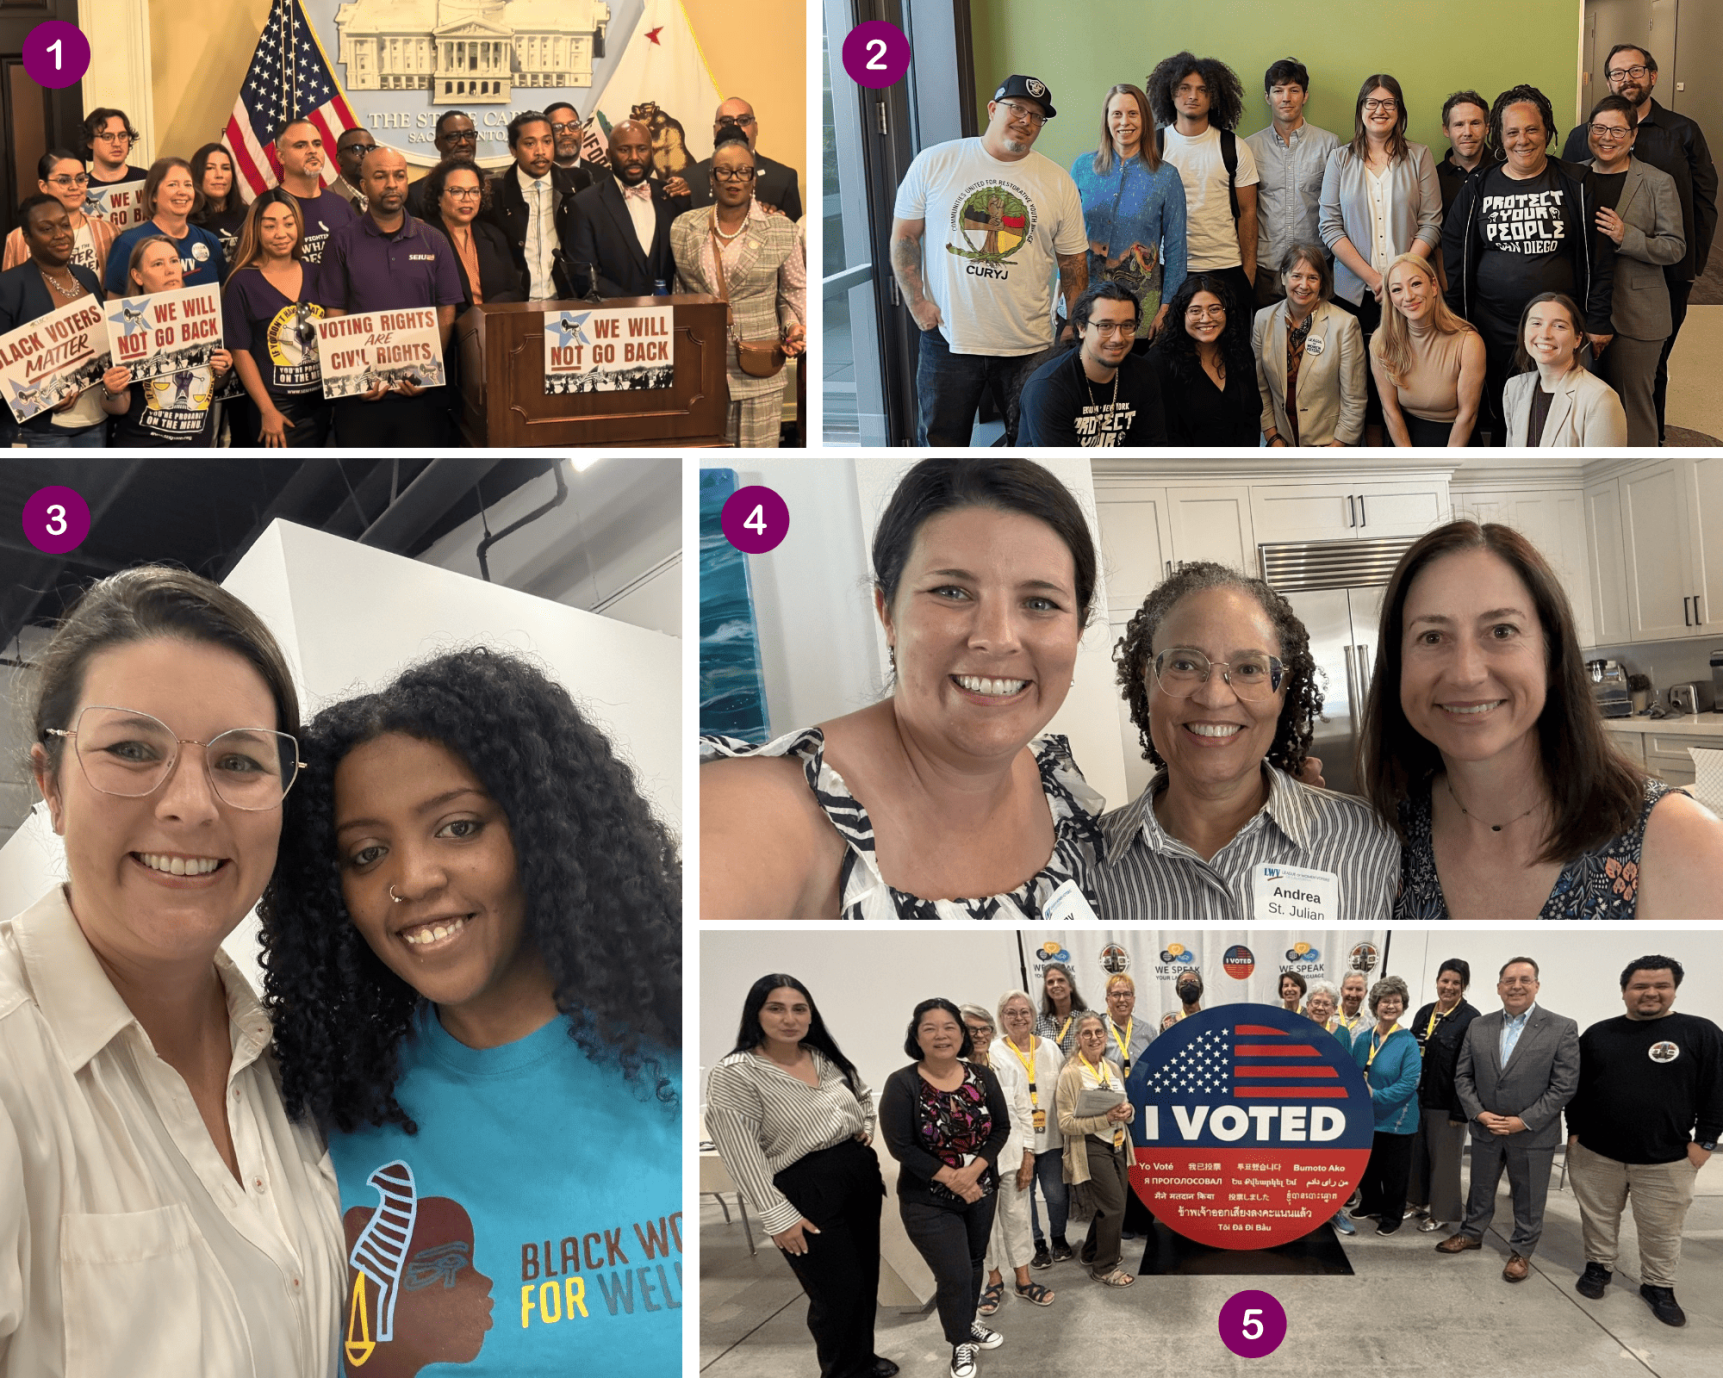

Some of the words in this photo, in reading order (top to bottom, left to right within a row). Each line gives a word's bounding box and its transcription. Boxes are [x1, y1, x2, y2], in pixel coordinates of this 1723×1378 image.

[367, 112, 411, 128] THE
[416, 112, 478, 127] STE
[965, 179, 985, 195] UNITED
[110, 192, 130, 208] WE
[1482, 189, 1564, 213] PROTECT
[110, 210, 127, 225] GO
[1499, 206, 1549, 222] YOUR
[1486, 220, 1566, 241] PEOPLE
[1523, 240, 1559, 255] DIEGO
[965, 264, 1009, 281] CURYJ
[153, 302, 178, 324] WE
[182, 295, 216, 318] WILL
[44, 305, 102, 343] VOTERS
[318, 316, 374, 340] VOTING
[379, 310, 436, 332] RIGHTS
[593, 318, 621, 339] WE
[627, 316, 669, 338] WILL
[117, 332, 148, 355] NOT
[155, 326, 175, 348] GO
[181, 317, 219, 342] BACK
[364, 332, 394, 347] ARE
[25, 333, 90, 378] MATTER
[330, 348, 370, 370] CIVIL
[376, 342, 432, 365] RIGHTS
[550, 345, 584, 366] NOT
[592, 343, 616, 364] GO
[624, 340, 669, 362] BACK
[279, 374, 292, 383] ON
[294, 372, 310, 383] THE
[146, 415, 160, 426] ON
[161, 418, 179, 430] THE
[1073, 410, 1137, 435] PROTECT
[1273, 886, 1322, 905] Andrea
[1268, 901, 1285, 915] St.
[1288, 905, 1325, 920] Julian
[1155, 965, 1170, 974] WE
[1279, 964, 1294, 973] WE
[1296, 964, 1325, 973] SPEAK
[1145, 1105, 1160, 1140] I
[1171, 1104, 1347, 1142] VOTED
[1139, 1162, 1151, 1171] Yo
[1153, 1162, 1175, 1171] Voté
[1293, 1164, 1327, 1172] Bumoto
[1328, 1164, 1346, 1172] Ako
[1144, 1177, 1151, 1185] Я
[1152, 1177, 1223, 1185] ПРОГОЛОСОВАЛ
[521, 1226, 630, 1282] BLACK
[521, 1276, 590, 1328] FOR
